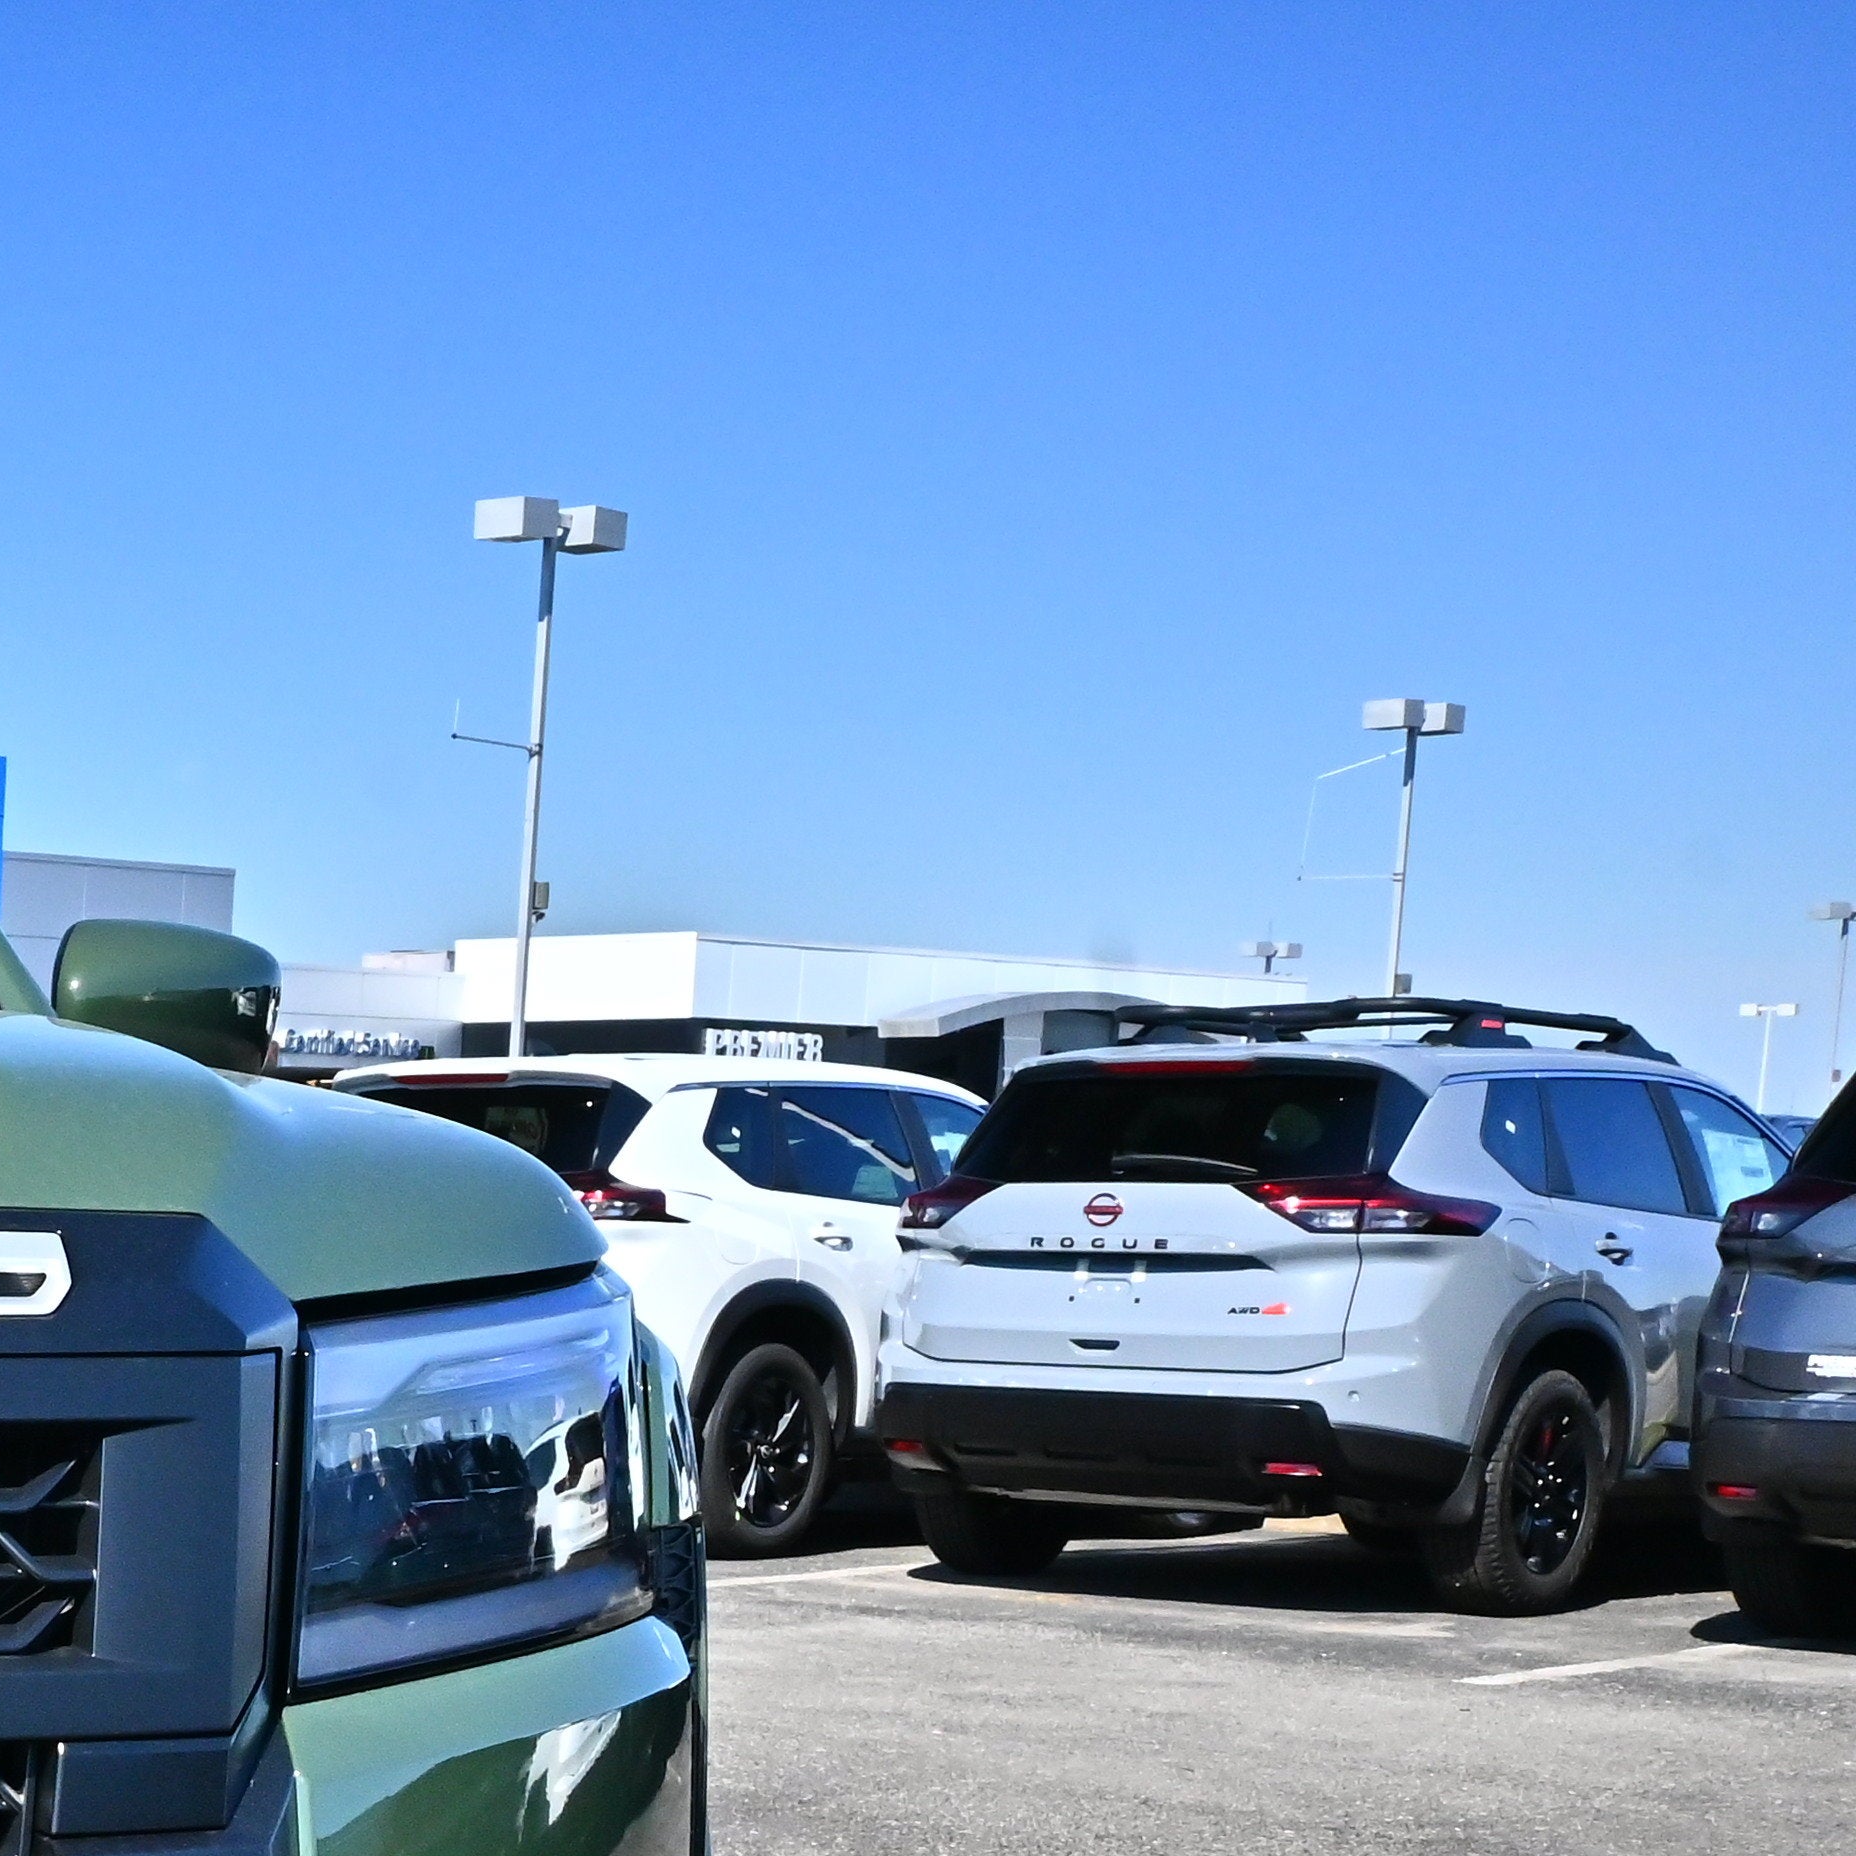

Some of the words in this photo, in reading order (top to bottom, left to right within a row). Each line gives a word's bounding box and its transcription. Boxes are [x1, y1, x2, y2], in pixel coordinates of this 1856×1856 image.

[704, 1028, 823, 1062] PREMIER
[1030, 1236, 1169, 1249] ROGUE
[1228, 1306, 1260, 1315] AWD
